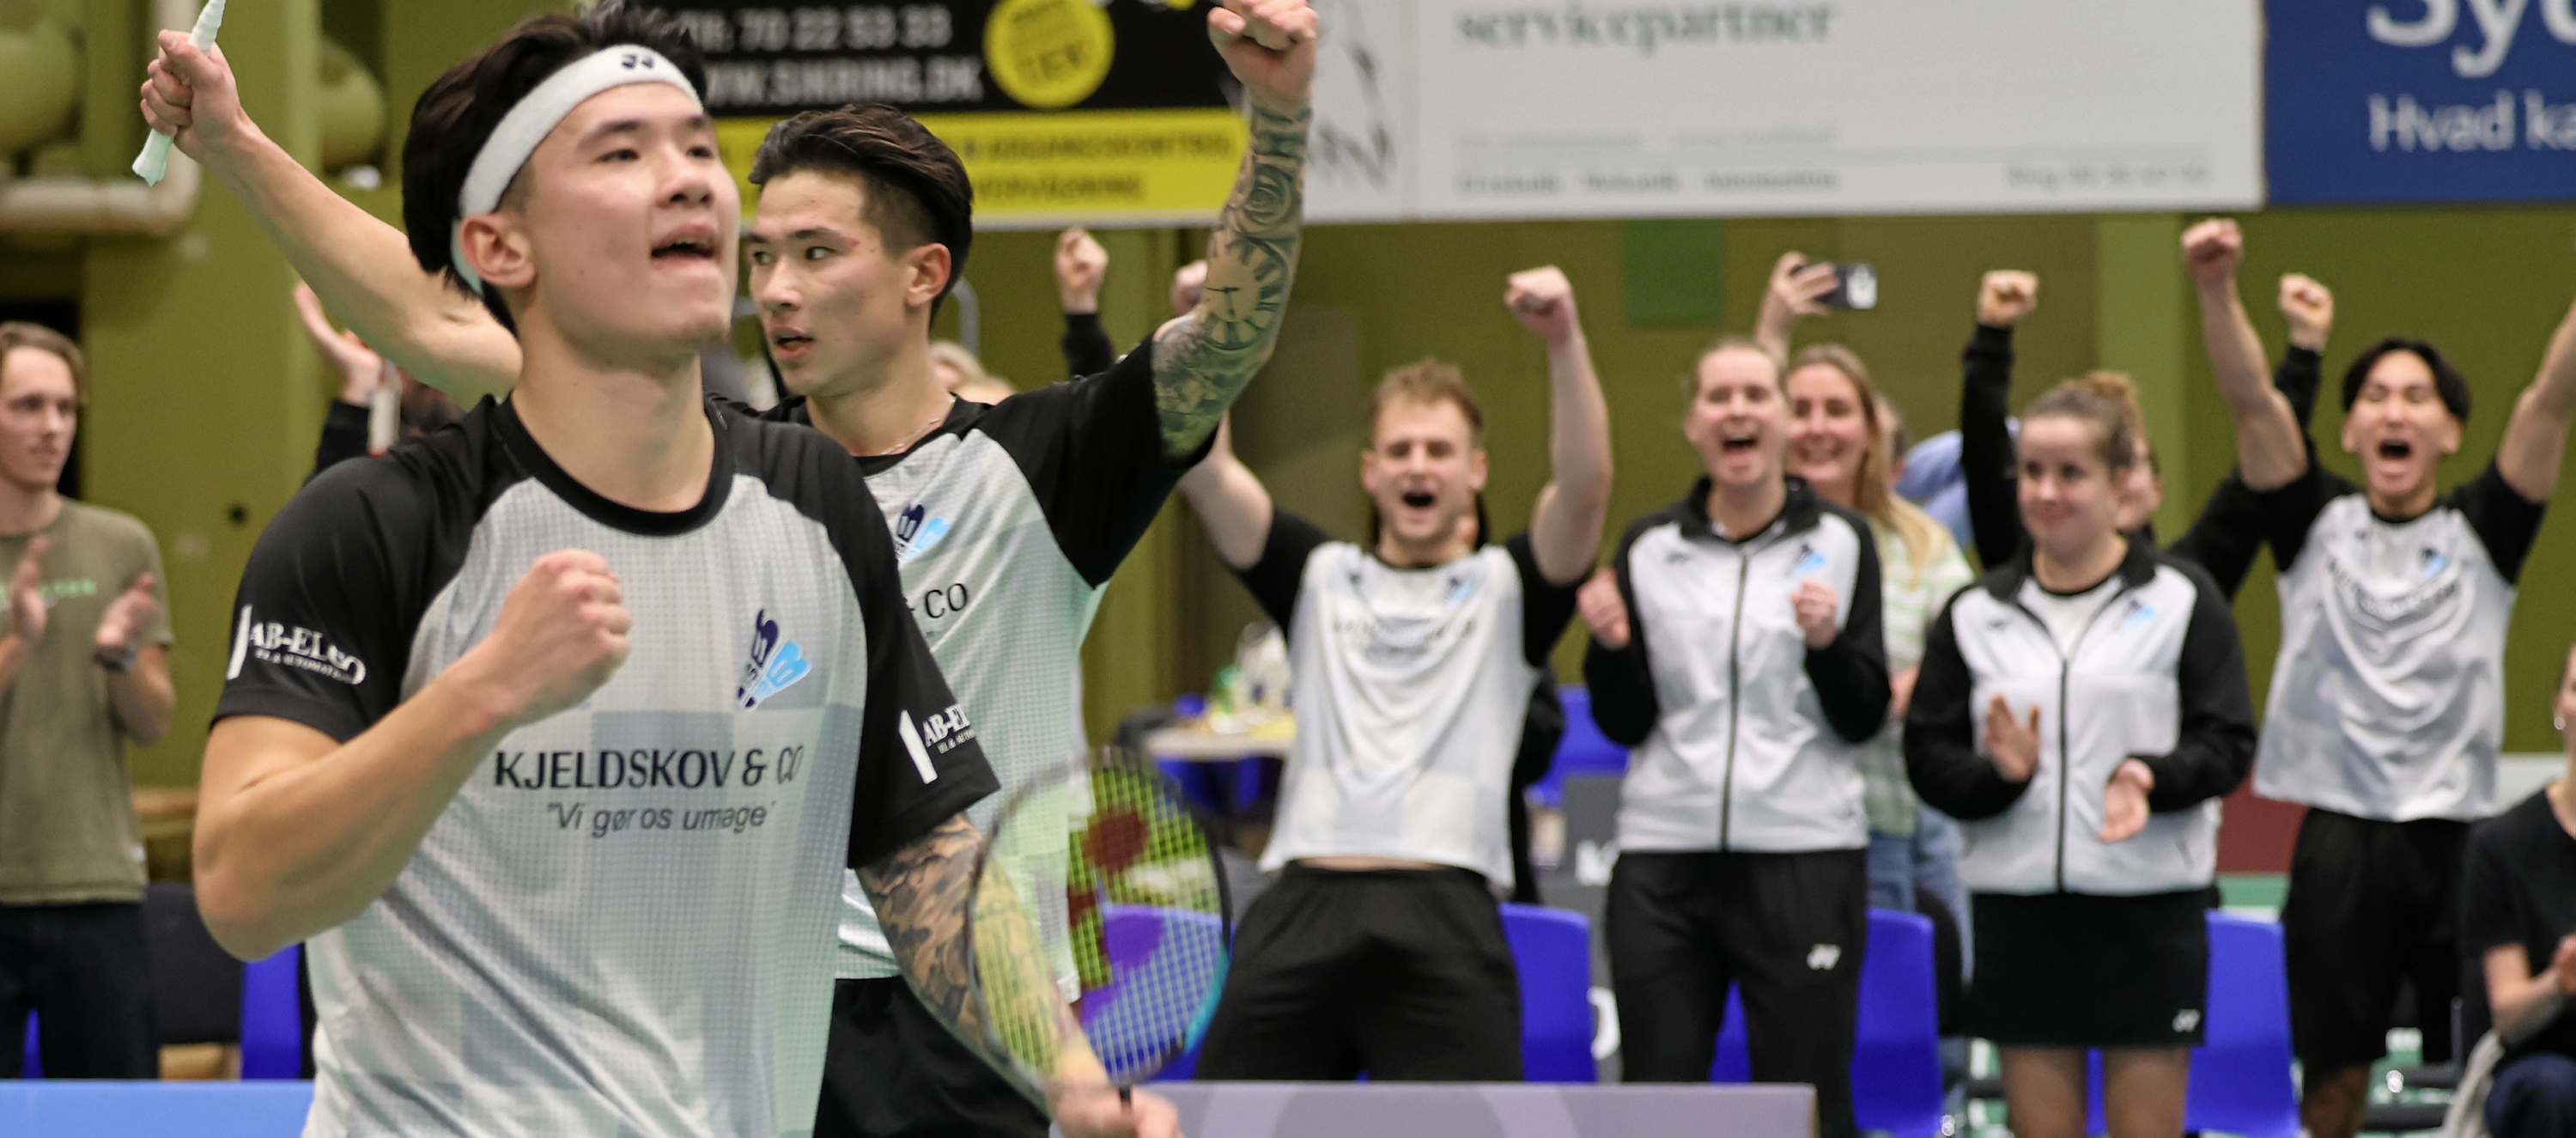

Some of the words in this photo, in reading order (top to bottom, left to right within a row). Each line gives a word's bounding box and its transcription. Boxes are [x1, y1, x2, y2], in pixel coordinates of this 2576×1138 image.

[1457, 2, 1832, 57] servicepartner
[2367, 88, 2517, 152] Hvad
[925, 583, 968, 618] CO
[495, 749, 735, 788] KJELDSKOV
[741, 749, 768, 786] &
[640, 806, 674, 830] os
